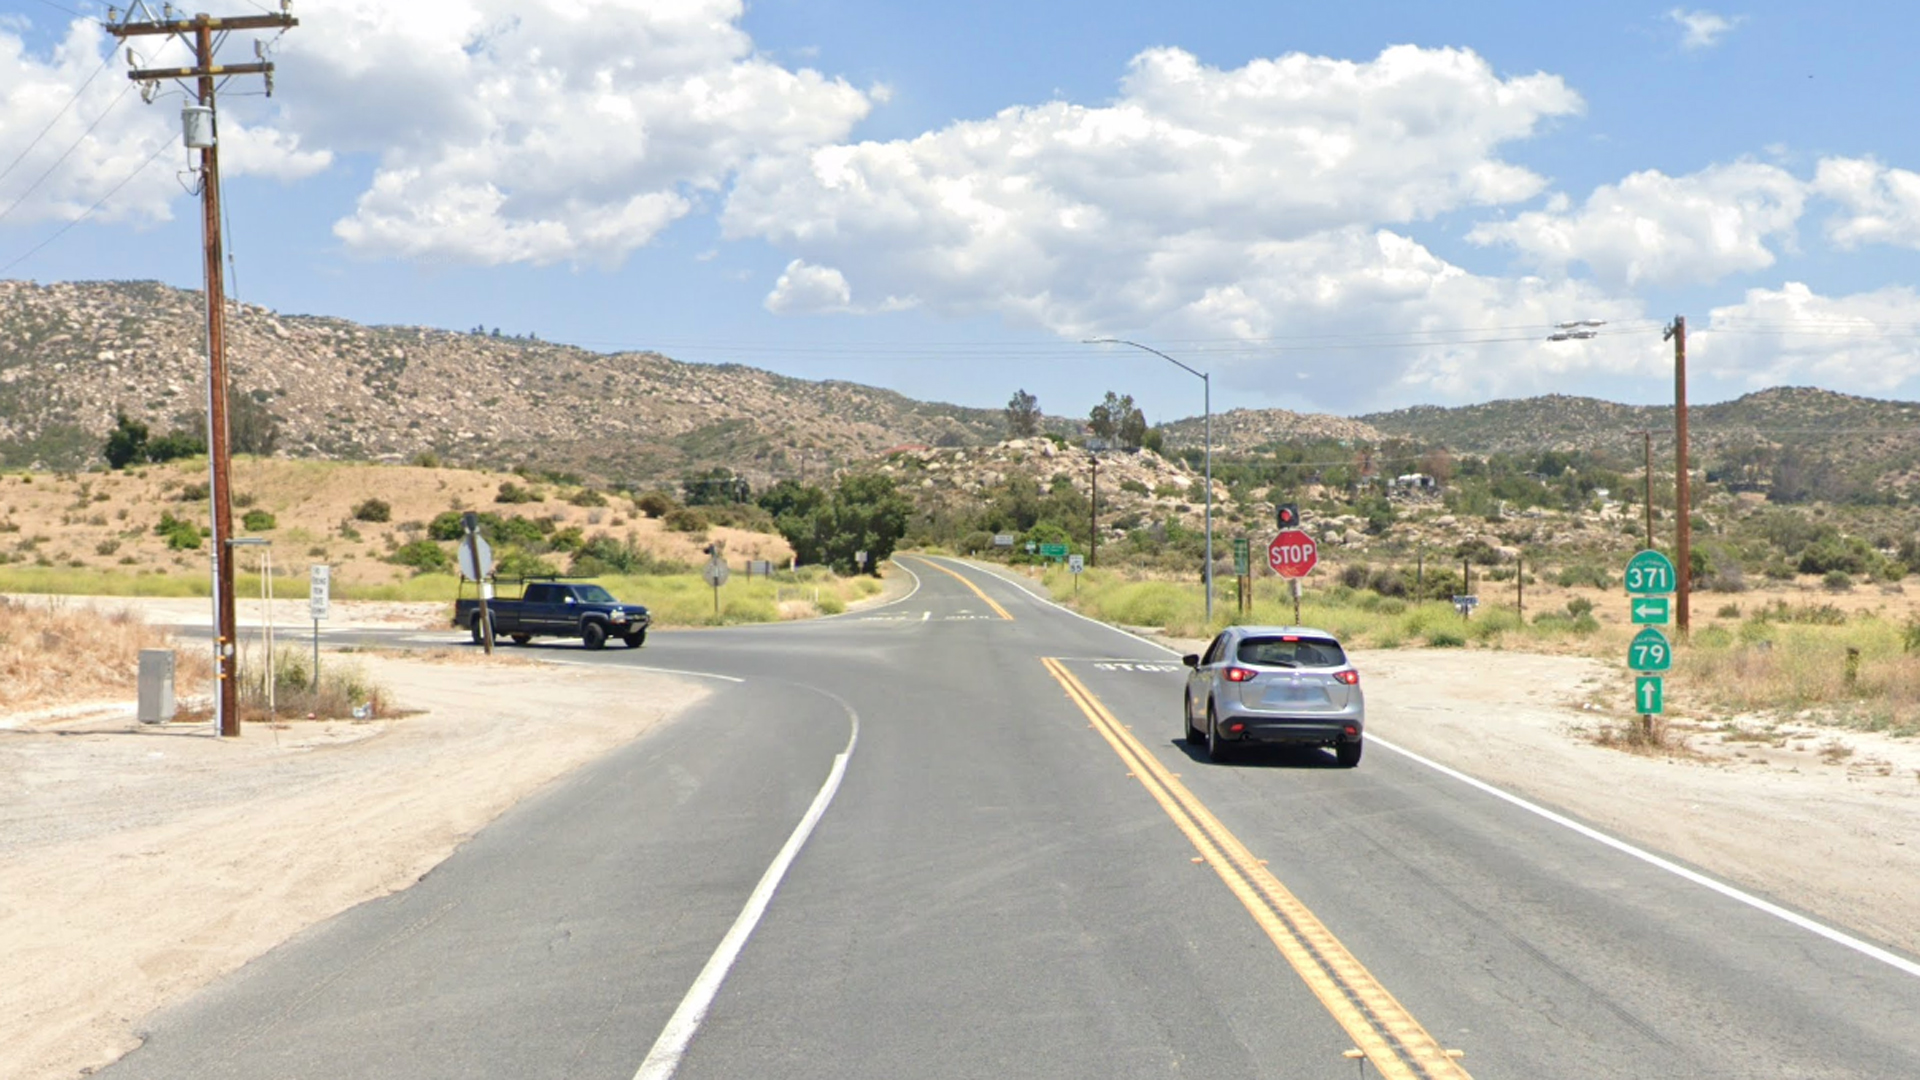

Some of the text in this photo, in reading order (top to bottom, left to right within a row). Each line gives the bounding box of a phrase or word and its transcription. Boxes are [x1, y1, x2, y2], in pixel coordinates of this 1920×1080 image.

[1271, 544, 1313, 565] STOP
[1629, 568, 1665, 588] 371
[1634, 645, 1664, 666] 79
[1093, 663, 1180, 673] STOP
